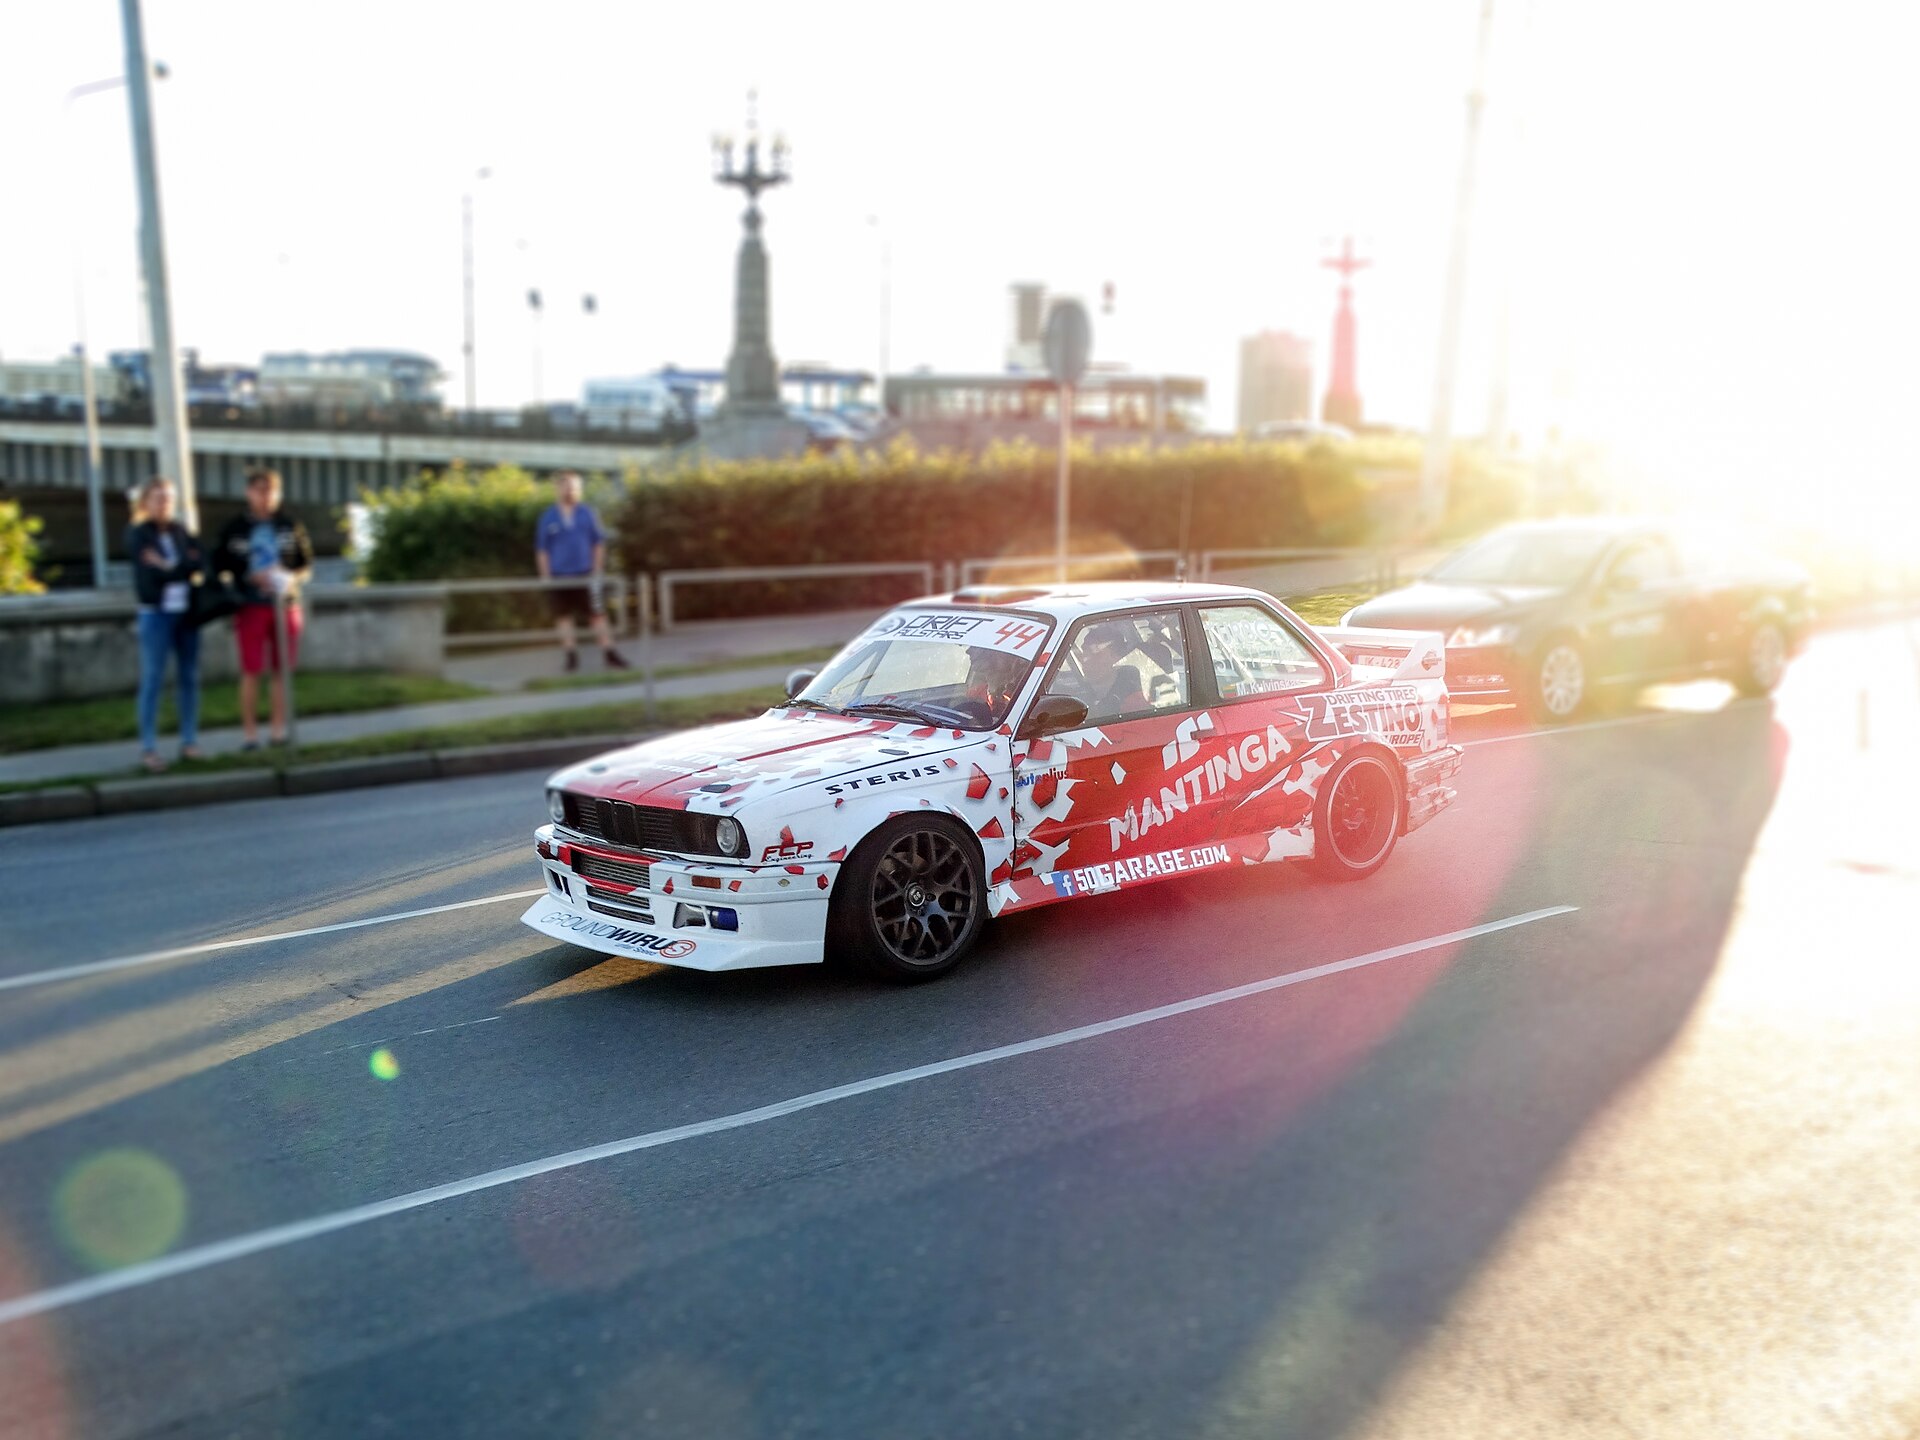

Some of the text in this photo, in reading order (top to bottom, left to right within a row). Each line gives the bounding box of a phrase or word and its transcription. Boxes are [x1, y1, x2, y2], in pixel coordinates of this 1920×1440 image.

[903, 615, 995, 632] DRIFT
[994, 621, 1046, 650] 44
[1326, 688, 1416, 706] DRIFTING TIRES
[1298, 696, 1422, 738] ZESTINO
[825, 766, 940, 795] STERIS
[1109, 725, 1292, 852] MANTINGA
